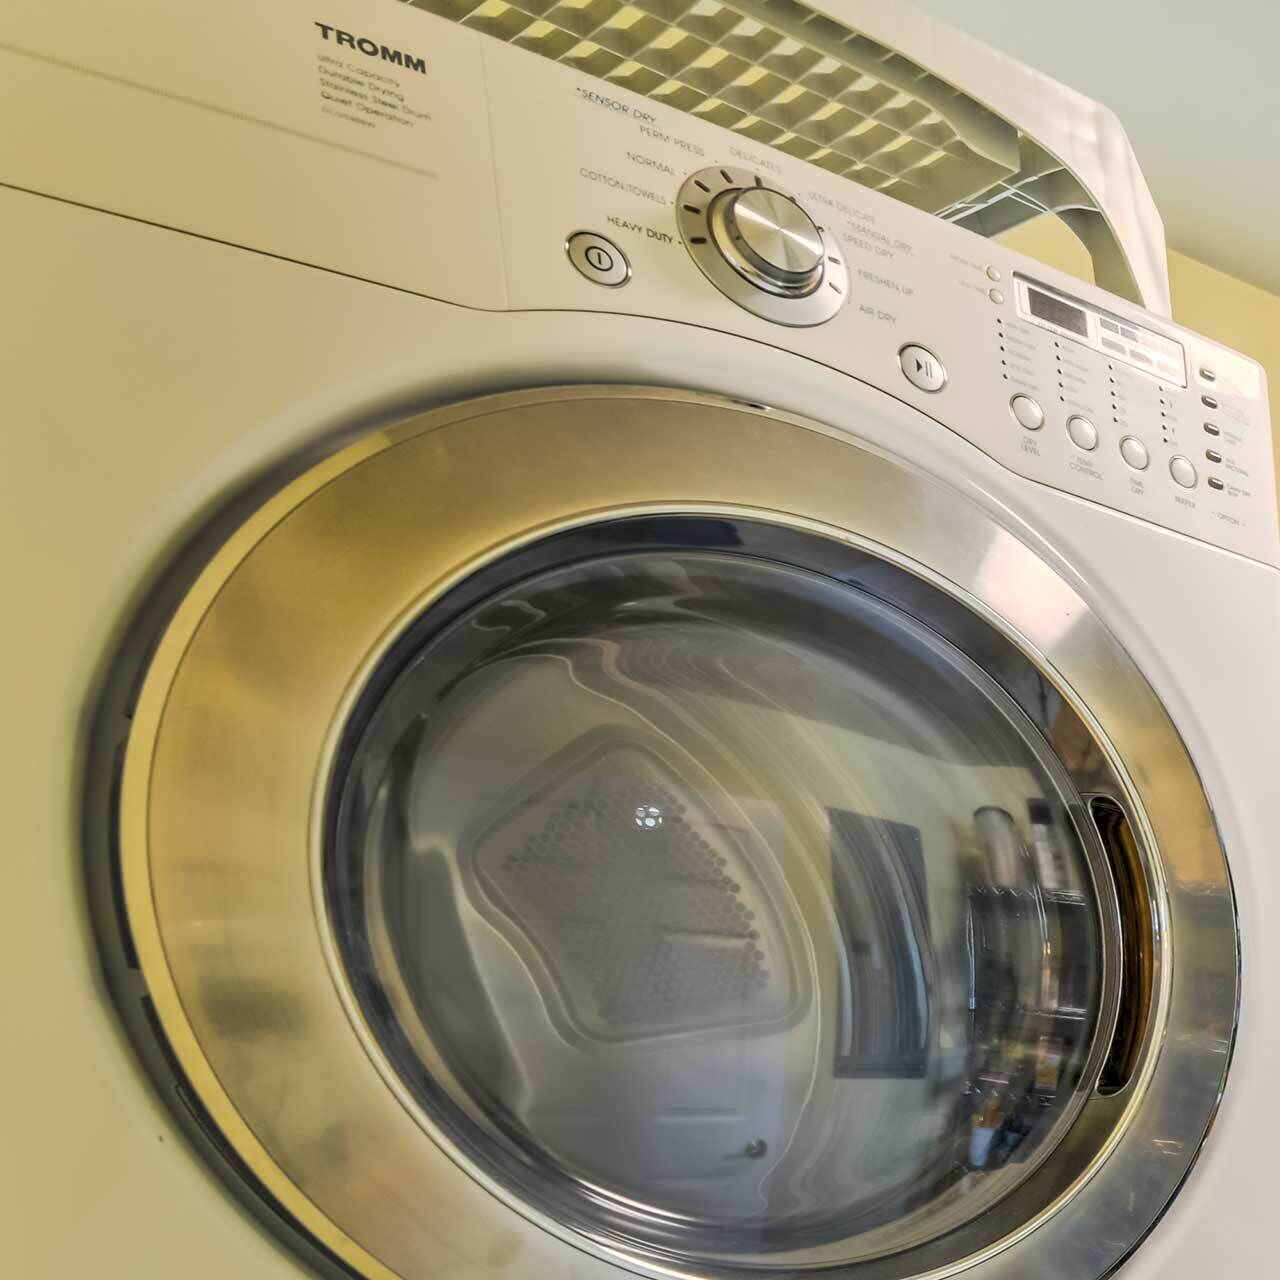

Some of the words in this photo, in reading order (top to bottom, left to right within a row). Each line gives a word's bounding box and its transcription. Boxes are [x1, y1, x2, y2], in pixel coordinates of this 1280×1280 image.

[315, 22, 426, 74] TROMM
[633, 108, 656, 124] DRY
[627, 152, 675, 176] NORMAL
[608, 215, 642, 233] HEAVY
[646, 228, 673, 244] DUTY
